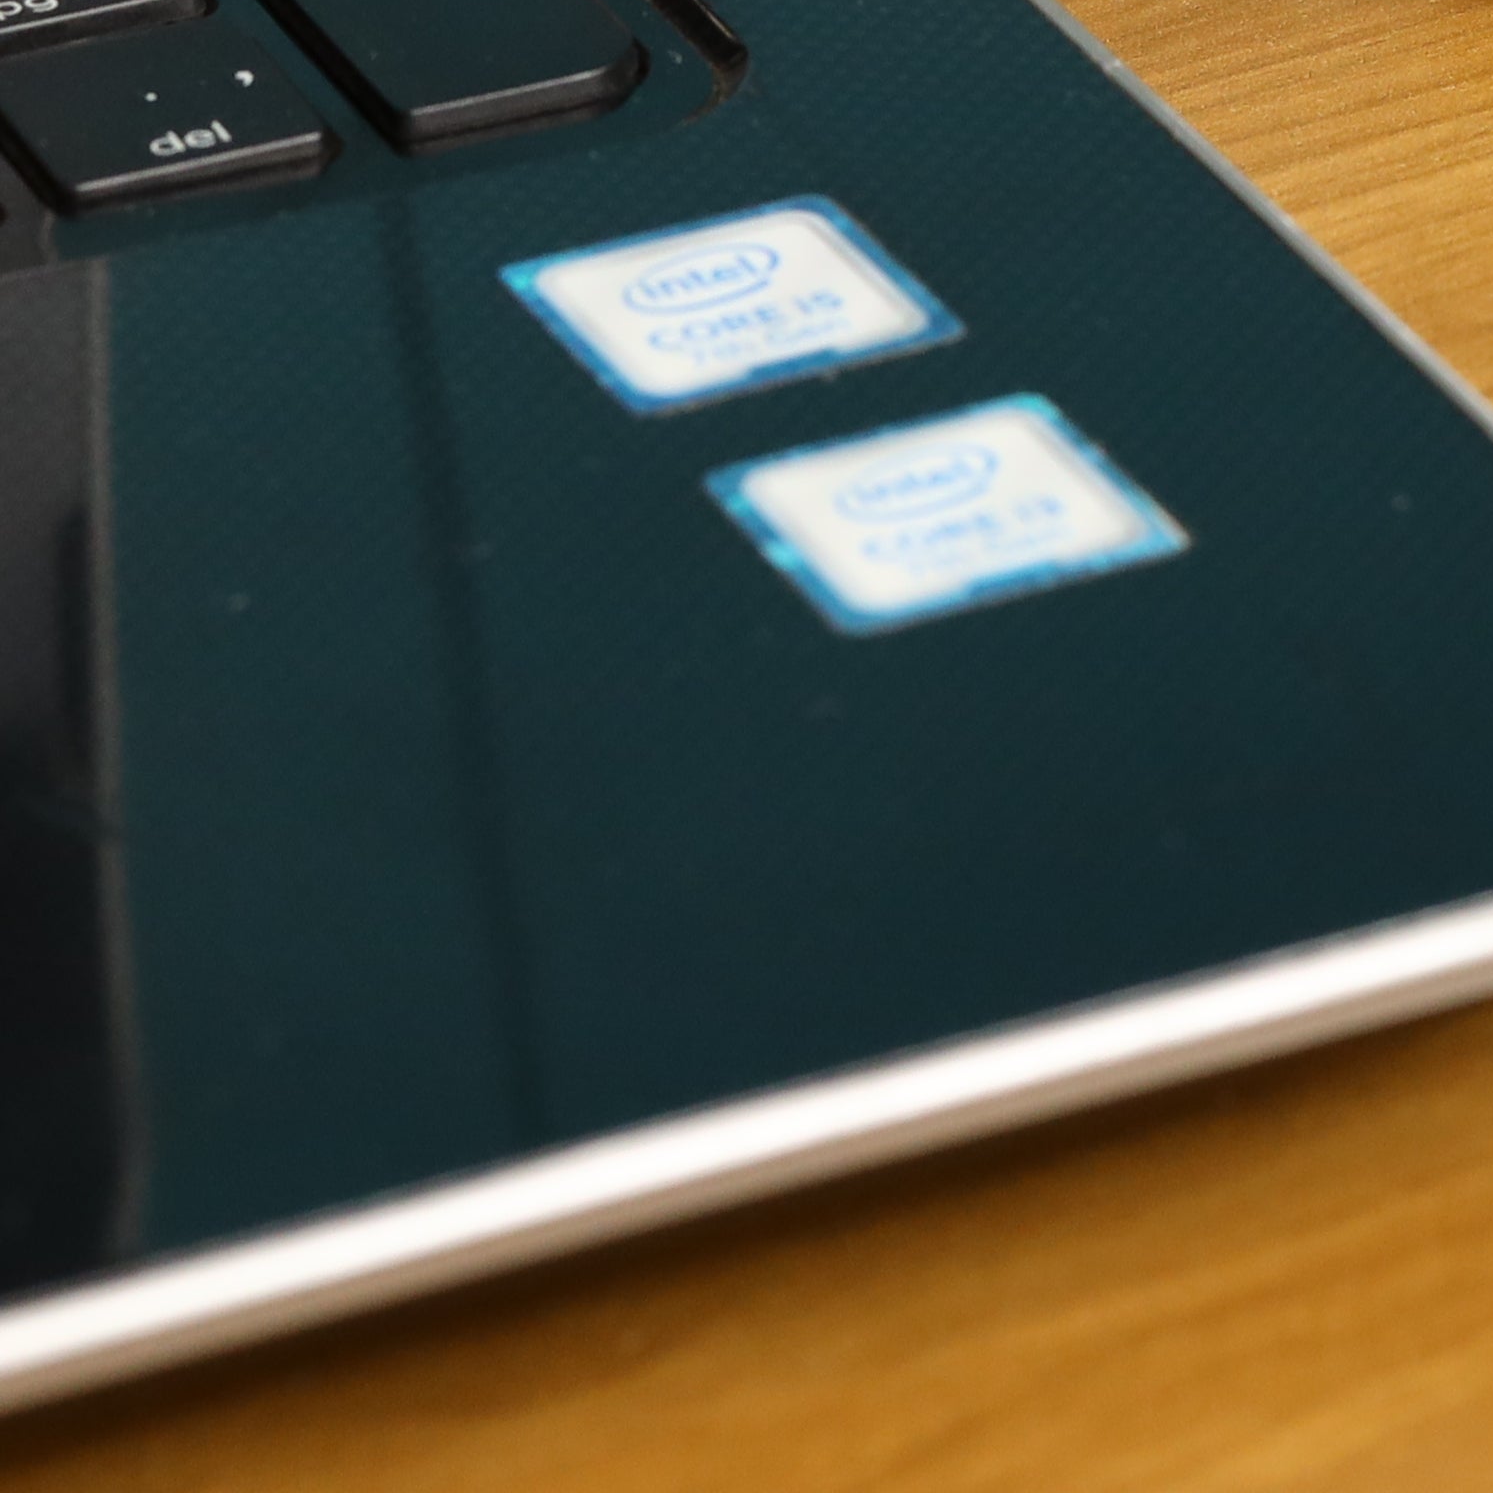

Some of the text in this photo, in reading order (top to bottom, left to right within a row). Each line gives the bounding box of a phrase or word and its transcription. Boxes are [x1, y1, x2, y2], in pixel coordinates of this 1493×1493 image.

[149, 119, 233, 158] del
[637, 254, 760, 301] intel
[646, 304, 788, 352] CORE
